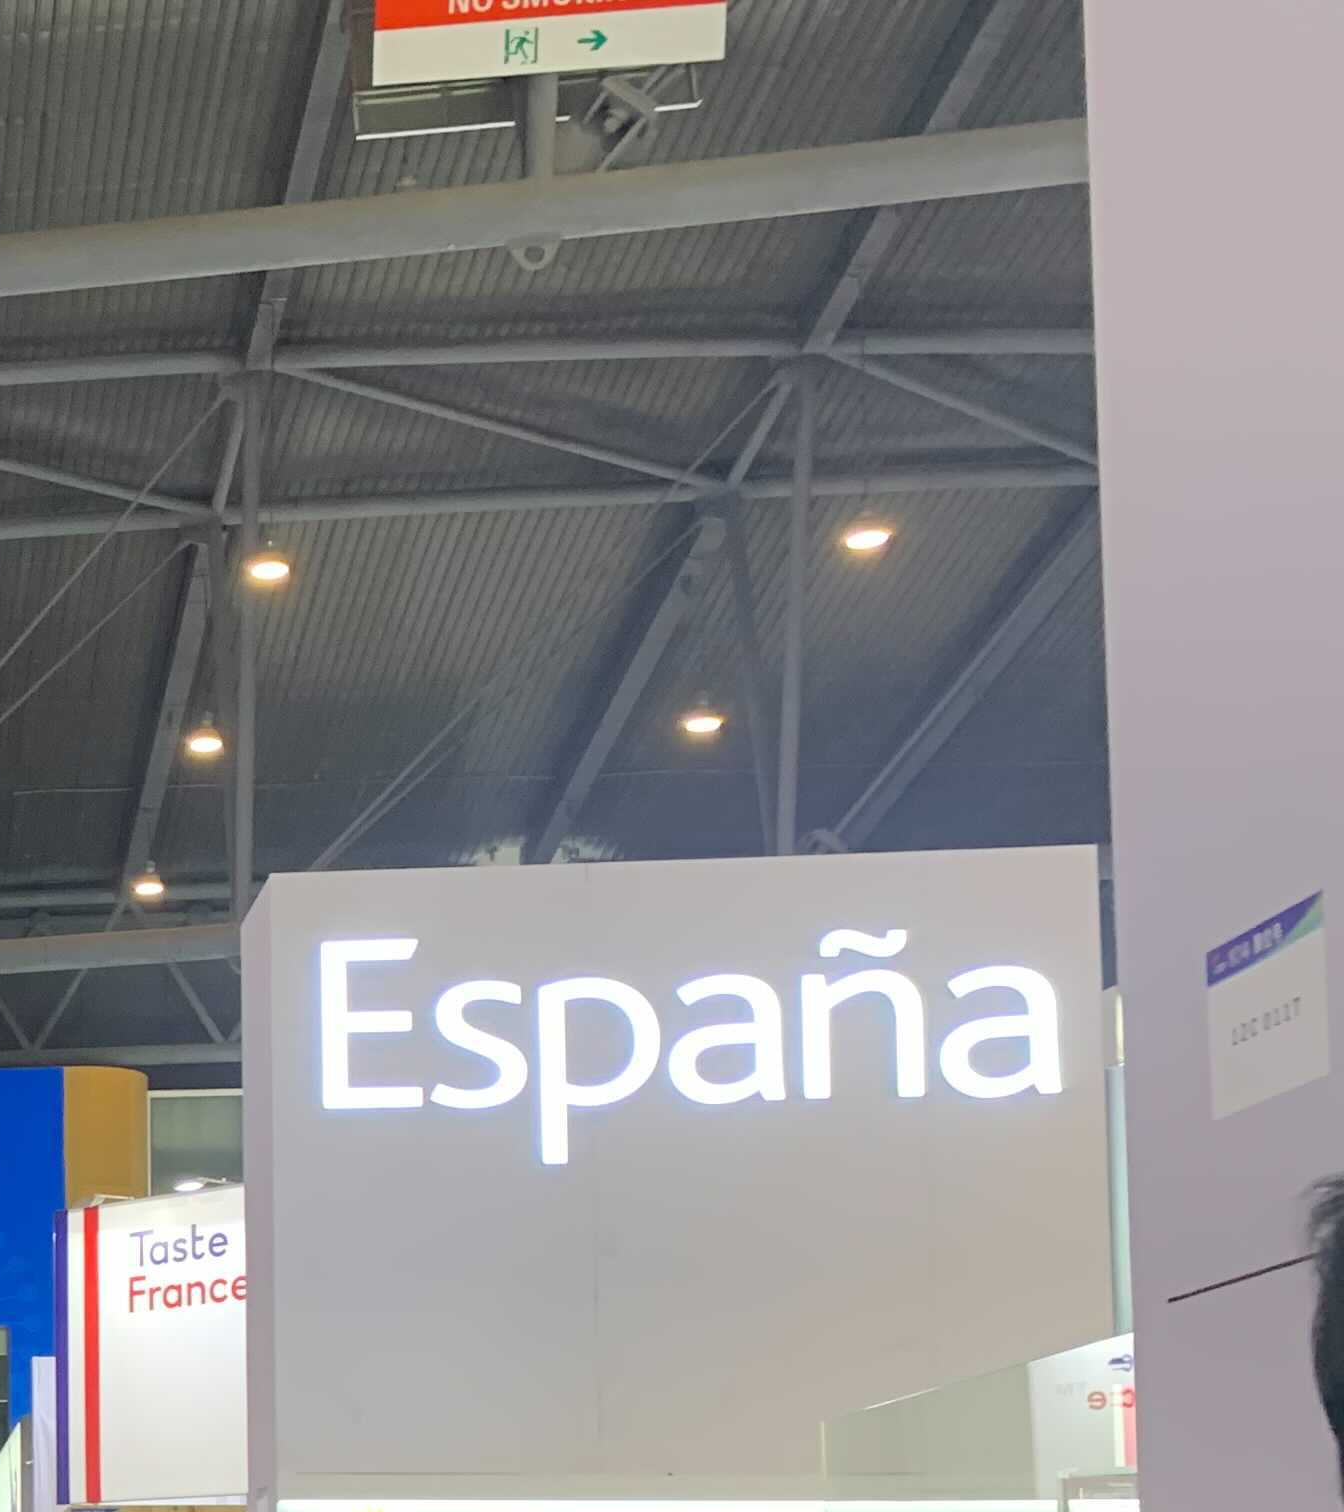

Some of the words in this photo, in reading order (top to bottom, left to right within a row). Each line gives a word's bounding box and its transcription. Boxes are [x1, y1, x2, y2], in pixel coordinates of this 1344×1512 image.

[318, 928, 1063, 1166] España
[129, 1223, 229, 1267] Taste
[127, 1273, 247, 1313] France
